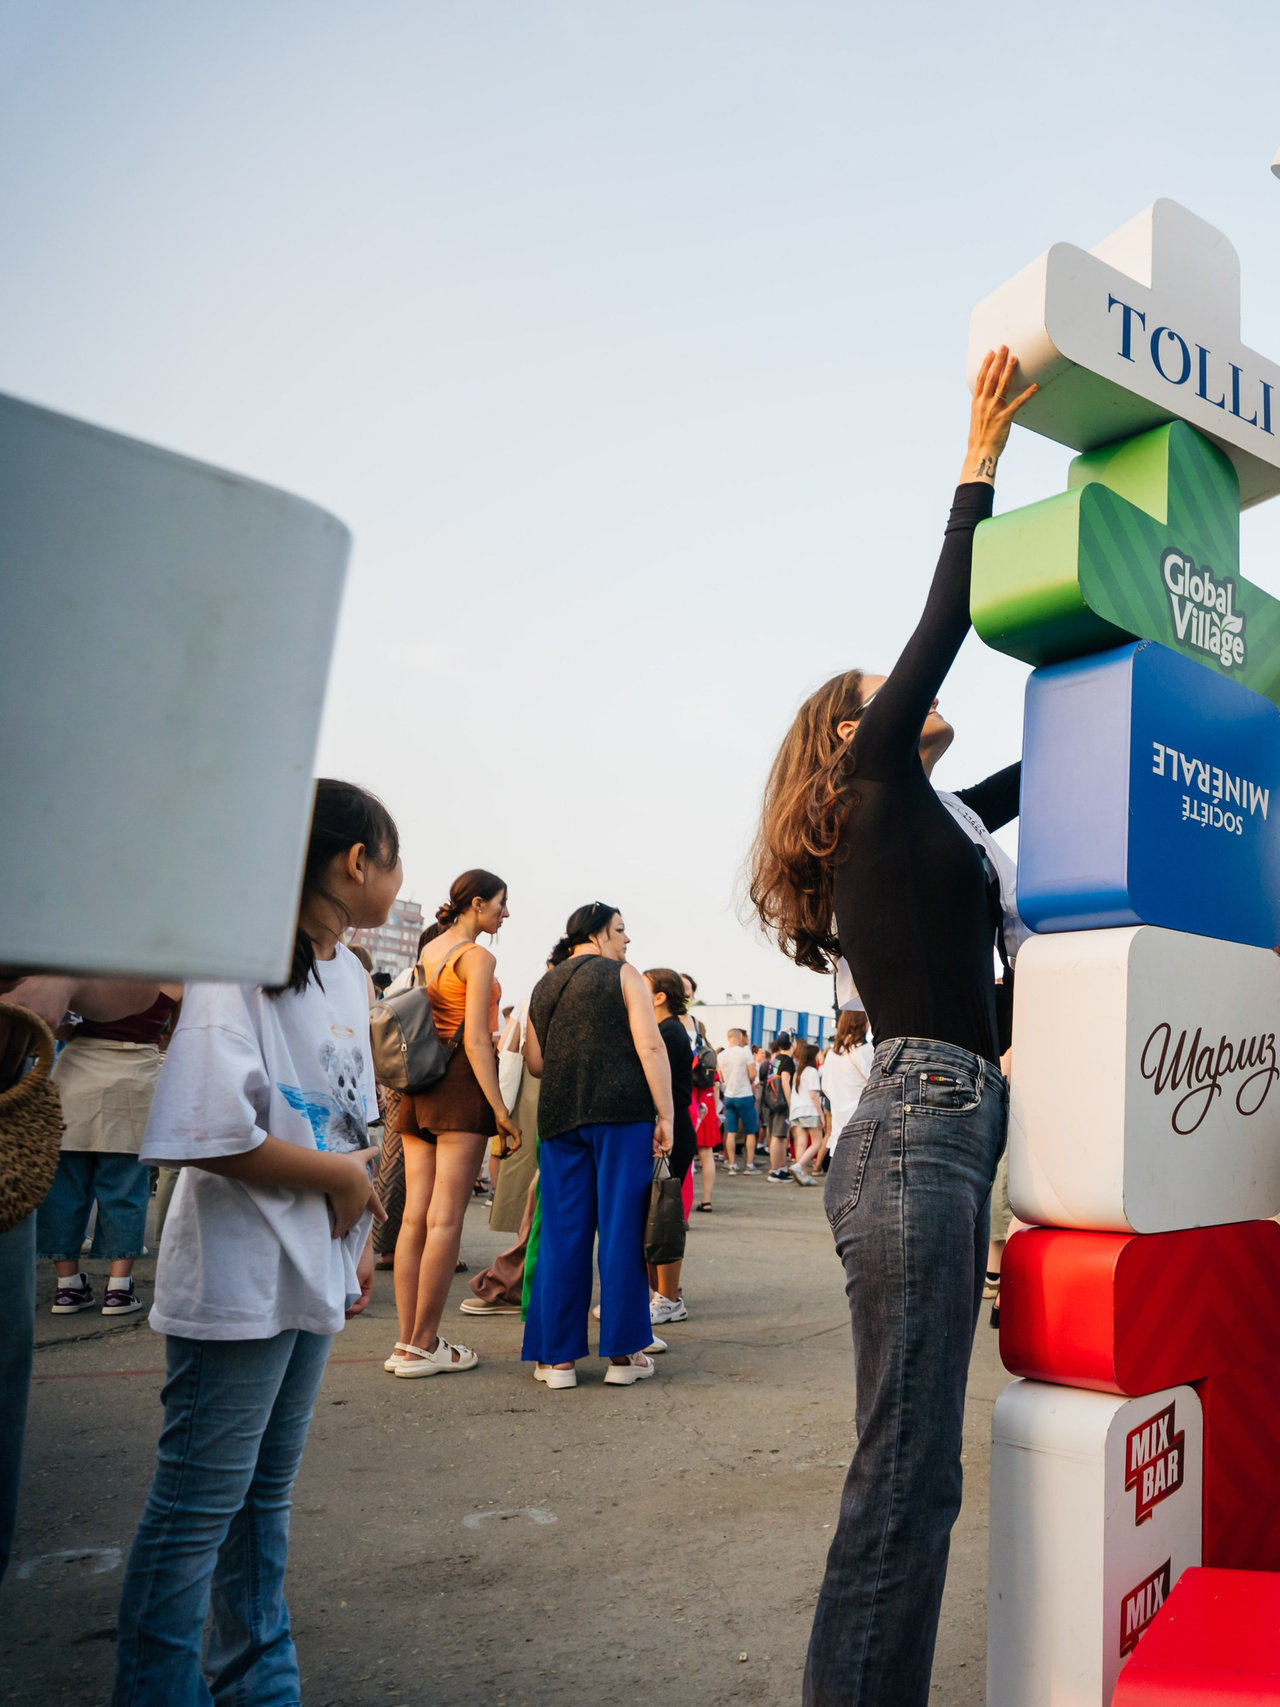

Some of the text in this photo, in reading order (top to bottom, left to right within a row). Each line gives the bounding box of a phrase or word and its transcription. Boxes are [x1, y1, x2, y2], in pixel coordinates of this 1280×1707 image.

[1108, 293, 1275, 436] TOLLI
[1164, 553, 1233, 616] Global
[1170, 592, 1244, 667] Village
[1152, 741, 1270, 821] MINÉRALE
[1182, 795, 1244, 836] SOCIÉTÉ
[1130, 1413, 1170, 1472] MIX
[1142, 1449, 1179, 1505] BAR
[1125, 1572, 1166, 1637] MIX
